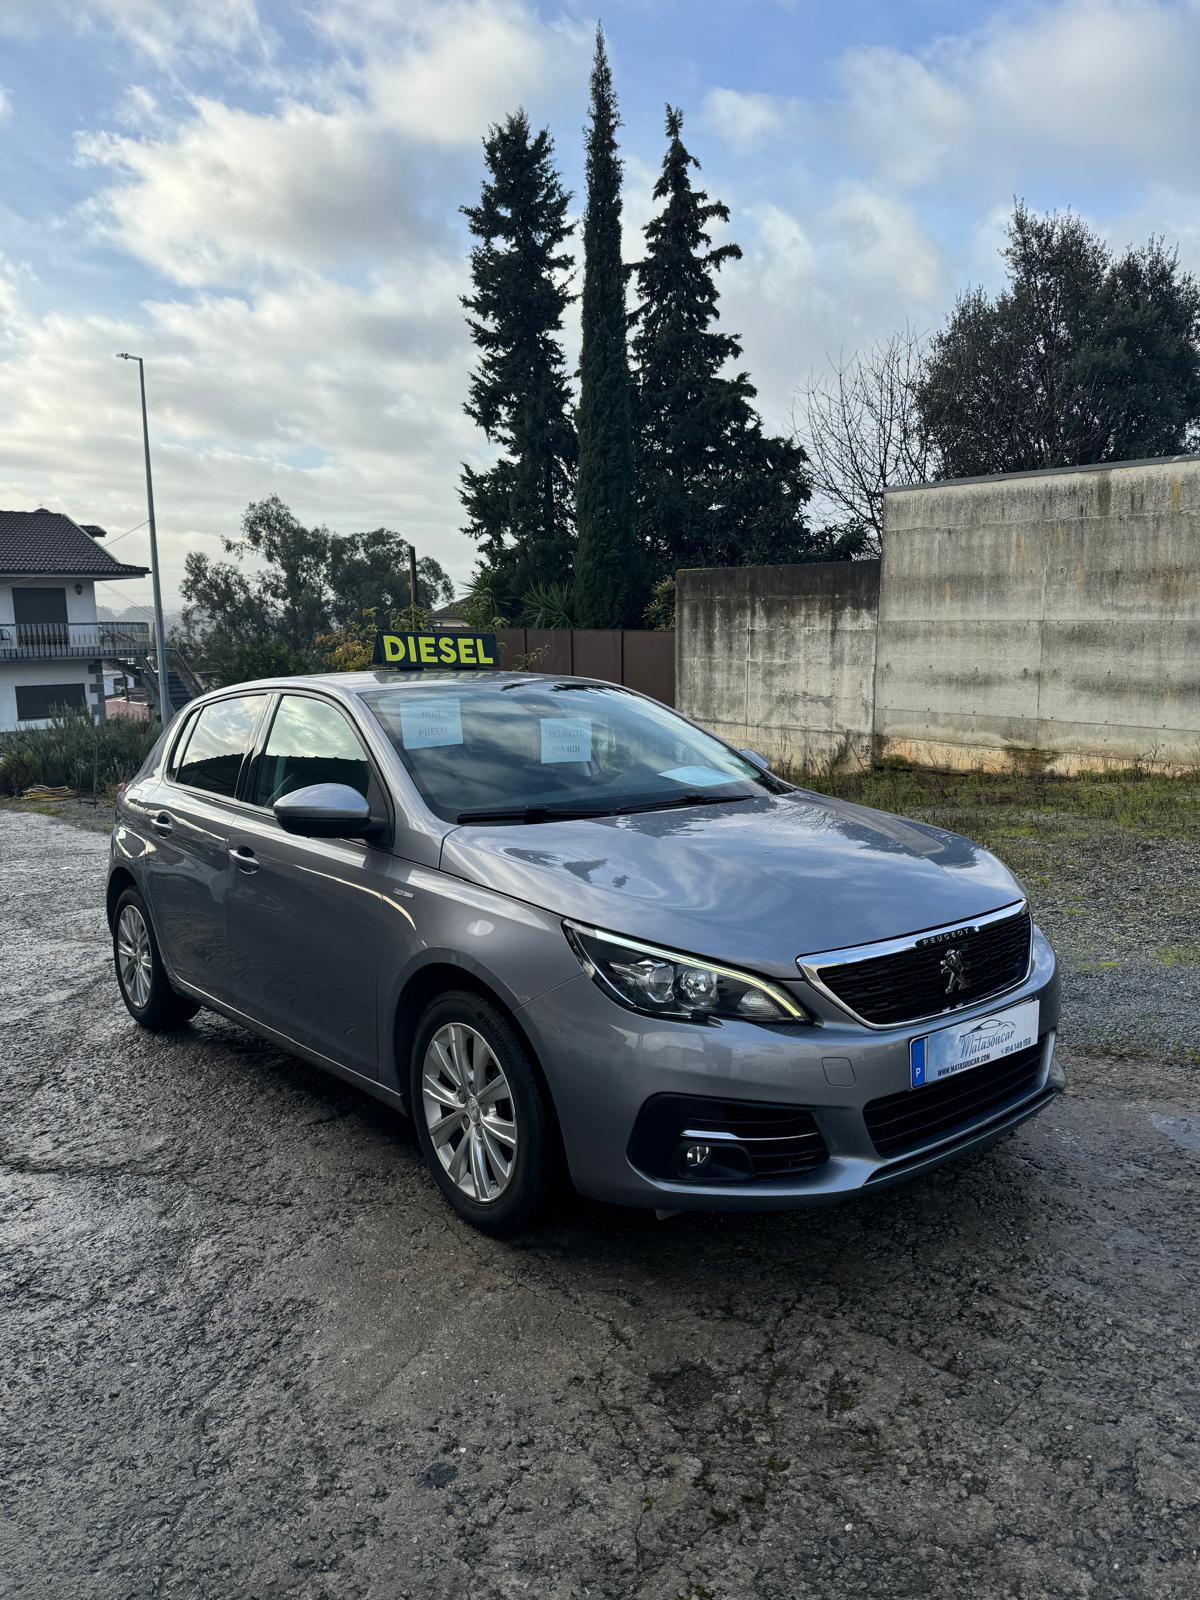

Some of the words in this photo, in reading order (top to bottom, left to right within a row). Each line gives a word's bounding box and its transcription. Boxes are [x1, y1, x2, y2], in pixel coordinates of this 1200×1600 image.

[382, 635, 494, 664] DIESEL
[418, 727, 447, 737] PREÇO
[549, 728, 584, 737] PEUGEOT
[922, 927, 969, 945] PEUGEOT
[959, 1029, 1015, 1058] Matasoucar
[915, 1066, 921, 1078] P
[937, 1053, 991, 1077] WWW.MATASOUCAR.COM
